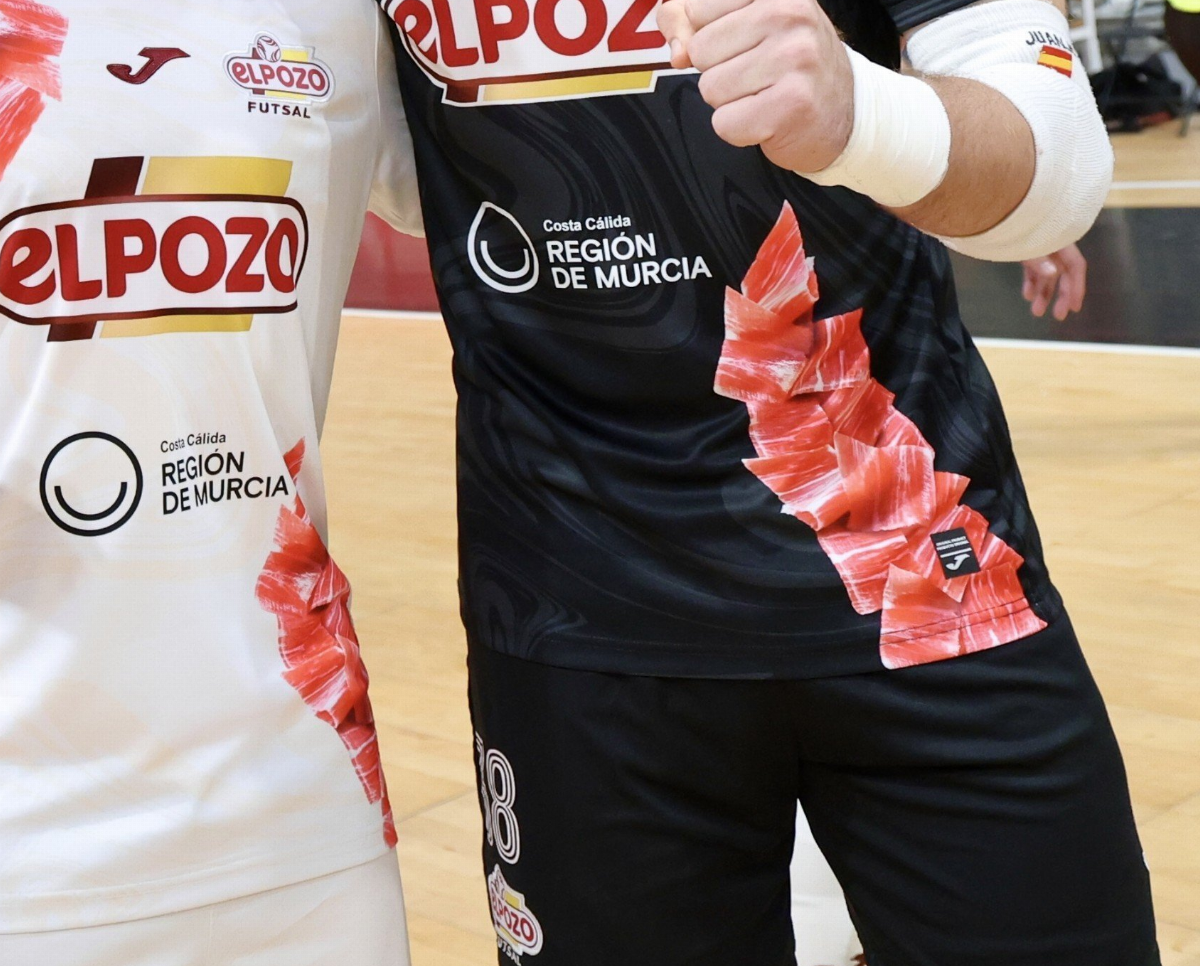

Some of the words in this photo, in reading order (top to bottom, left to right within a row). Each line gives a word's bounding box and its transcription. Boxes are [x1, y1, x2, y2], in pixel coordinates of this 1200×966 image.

[247, 101, 311, 119] FUTSAL
[543, 219, 582, 232] Costa
[585, 215, 631, 230] Cálida
[546, 232, 656, 263] REGIÓN
[551, 266, 588, 289] DE
[594, 256, 712, 289] MURCIA
[160, 438, 185, 453] Costa
[187, 432, 226, 447] Cálida
[162, 449, 245, 487] REGIÓN
[163, 487, 191, 515] DE
[194, 475, 289, 507] MURCIA
[497, 935, 522, 966] UTSAL
